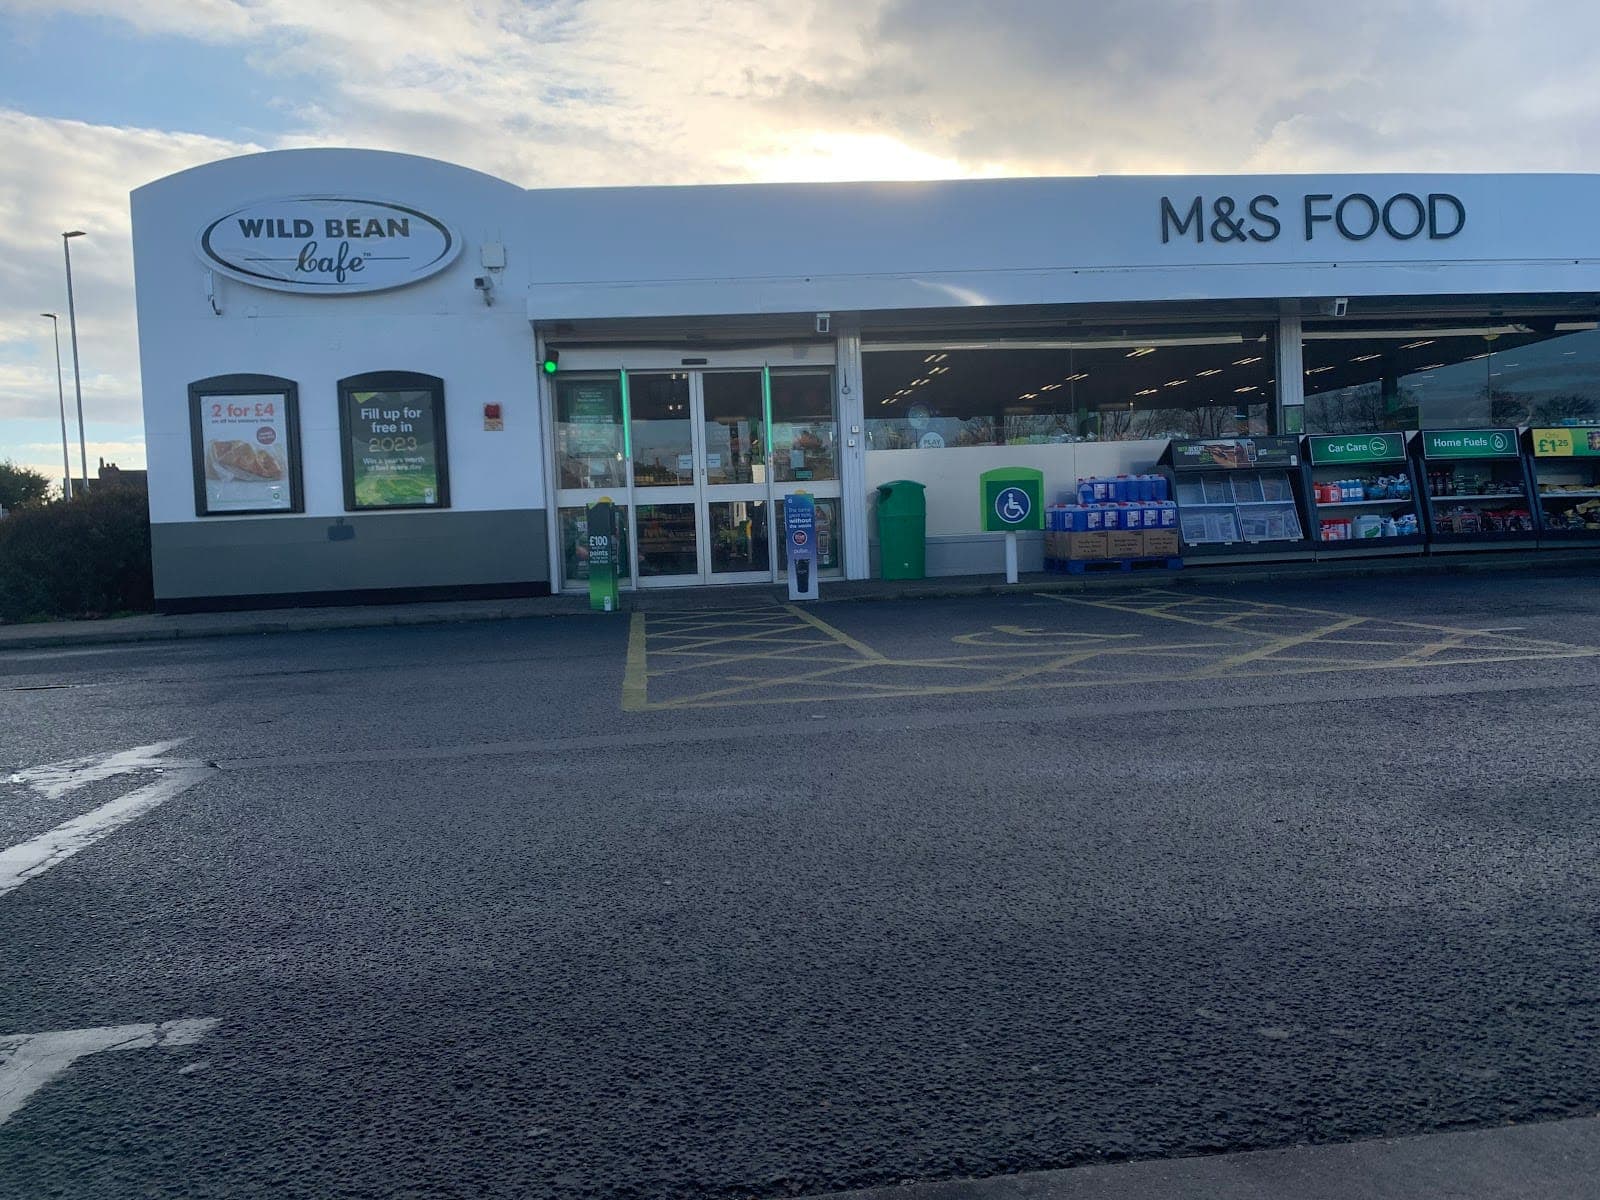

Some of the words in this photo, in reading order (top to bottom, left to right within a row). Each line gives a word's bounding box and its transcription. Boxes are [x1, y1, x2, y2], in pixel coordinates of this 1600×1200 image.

[1160, 194, 1282, 244] M&S
[1304, 192, 1466, 241] FOOD
[238, 218, 315, 238] WILD
[325, 217, 410, 238] BEAN
[294, 241, 366, 283] Cafe
[211, 404, 222, 417] 2
[227, 403, 250, 417] for
[254, 402, 274, 417] £4
[360, 408, 380, 420] Fill
[383, 409, 401, 421] up
[404, 406, 423, 418] for
[371, 421, 397, 433] free
[400, 421, 413, 432] in
[368, 436, 418, 453] 2023
[1328, 443, 1344, 453] Car
[1346, 443, 1368, 452] Care
[1433, 438, 1461, 448] Home
[1463, 437, 1488, 447] Fuels
[589, 535, 608, 546] £100
